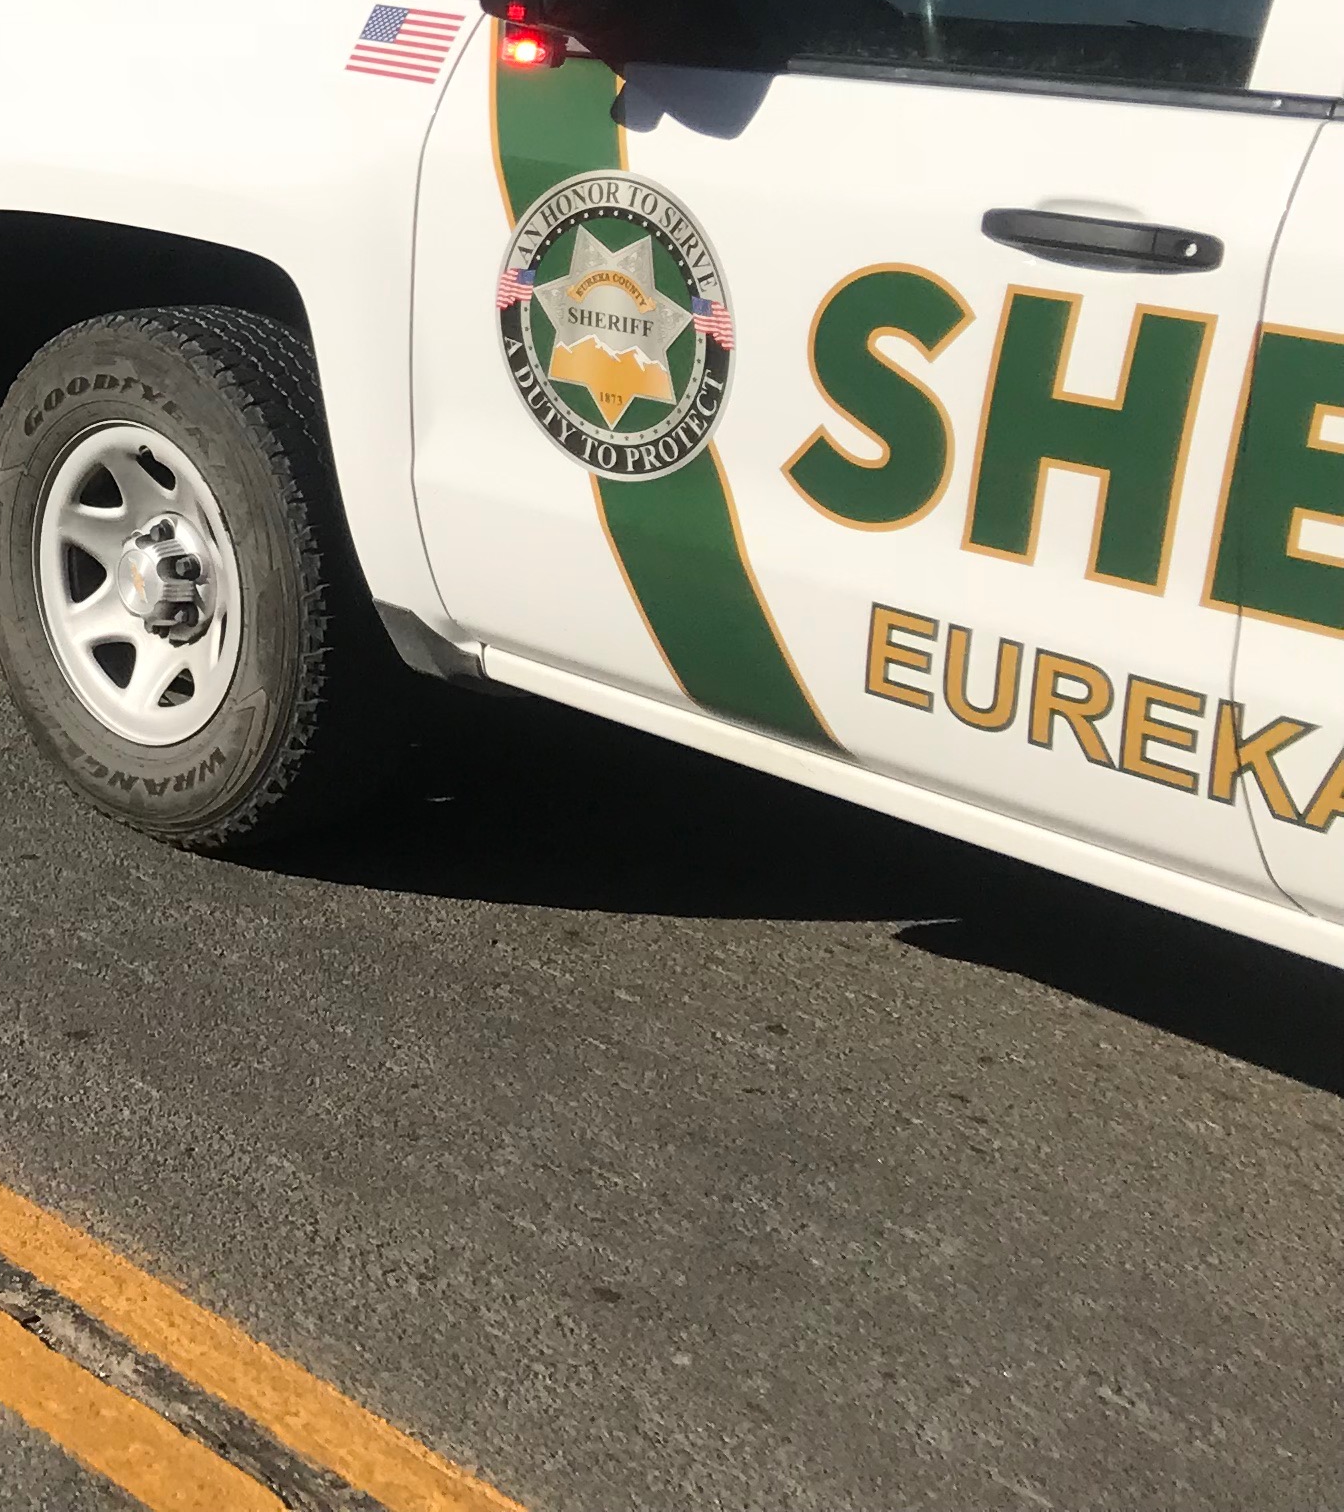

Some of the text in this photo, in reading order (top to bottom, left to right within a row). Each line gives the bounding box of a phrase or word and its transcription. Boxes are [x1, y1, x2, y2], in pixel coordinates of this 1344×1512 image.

[516, 181, 718, 294] AN HONOR TO SERVE
[568, 306, 654, 337] SHERIFF
[576, 273, 647, 306] EUREKA COUNTY
[503, 335, 724, 472] A DUTY TO PROTECT
[599, 391, 624, 405] 1873
[780, 262, 1344, 641] SHE
